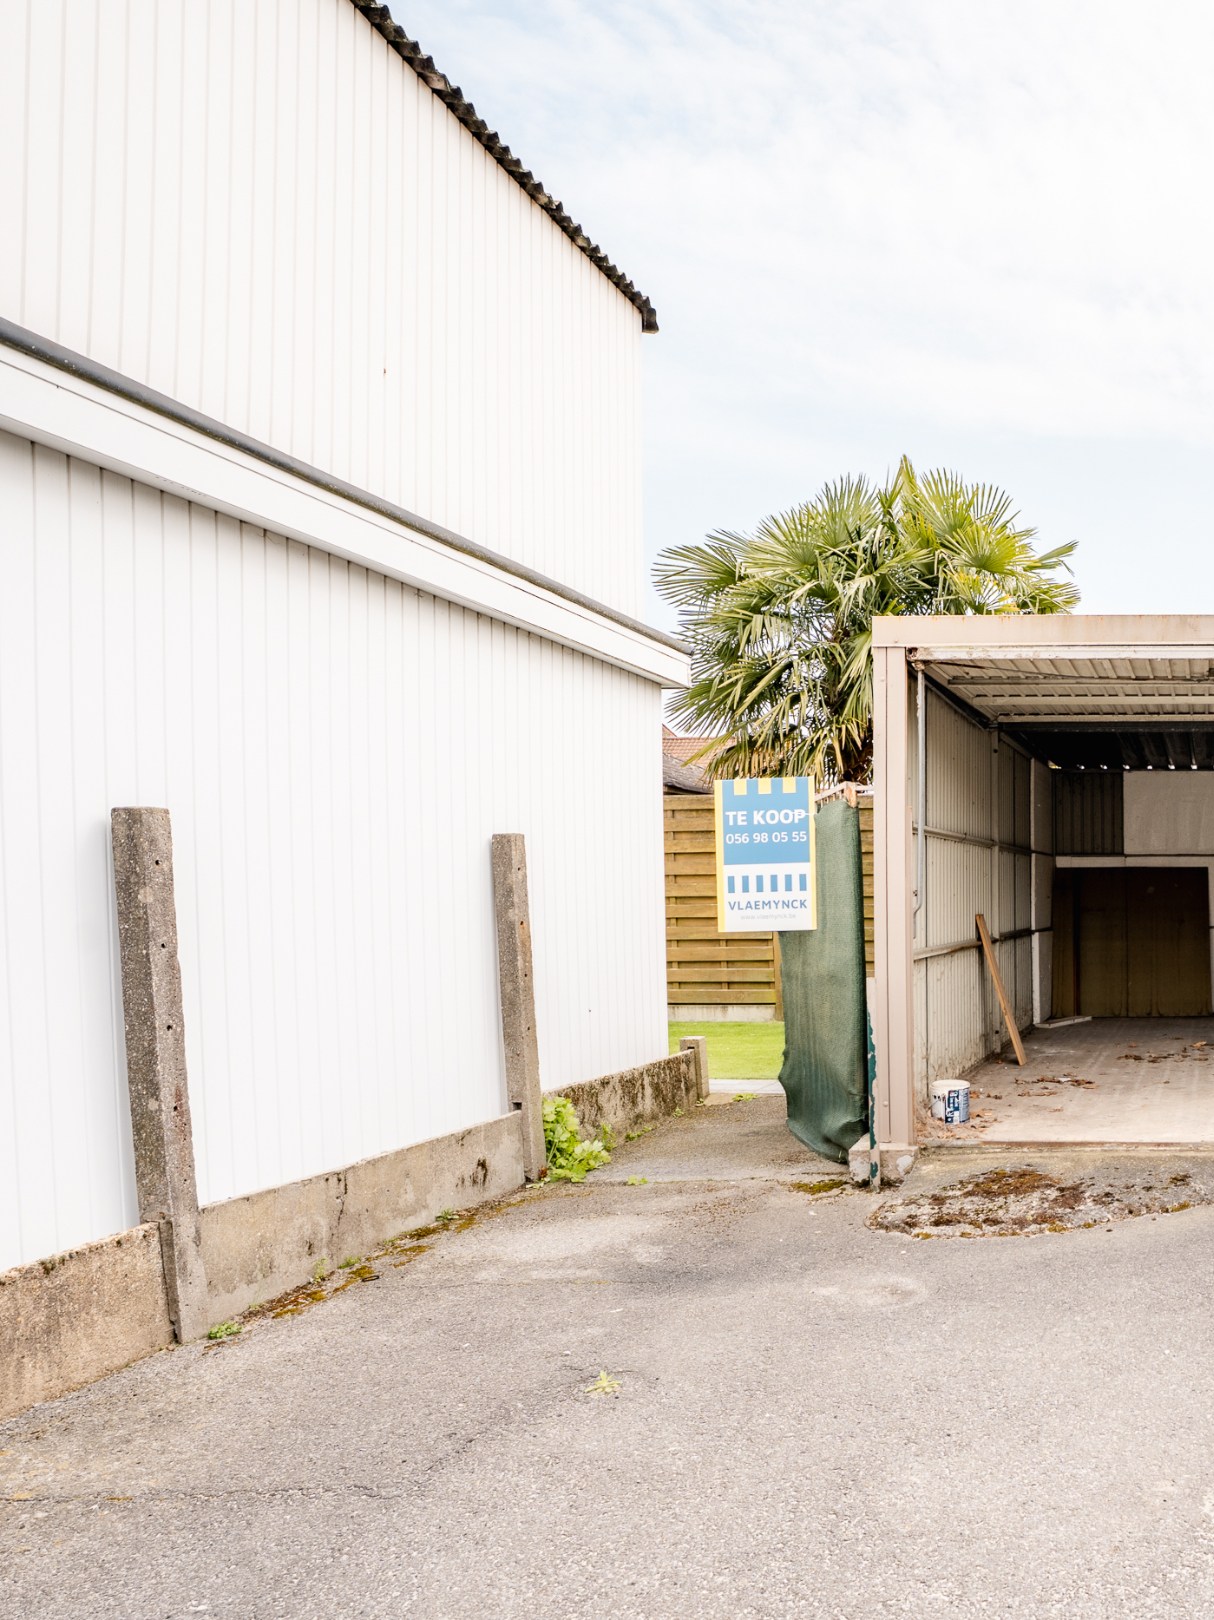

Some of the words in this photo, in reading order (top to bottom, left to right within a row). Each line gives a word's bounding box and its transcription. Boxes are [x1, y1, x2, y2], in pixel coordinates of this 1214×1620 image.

[725, 810, 748, 826] TE
[753, 808, 806, 825] KOOP
[725, 833, 750, 844] 056
[752, 832, 769, 844] 98
[771, 831, 789, 843] 05
[791, 830, 807, 842] 55
[728, 899, 807, 911] VLAEMYNCK
